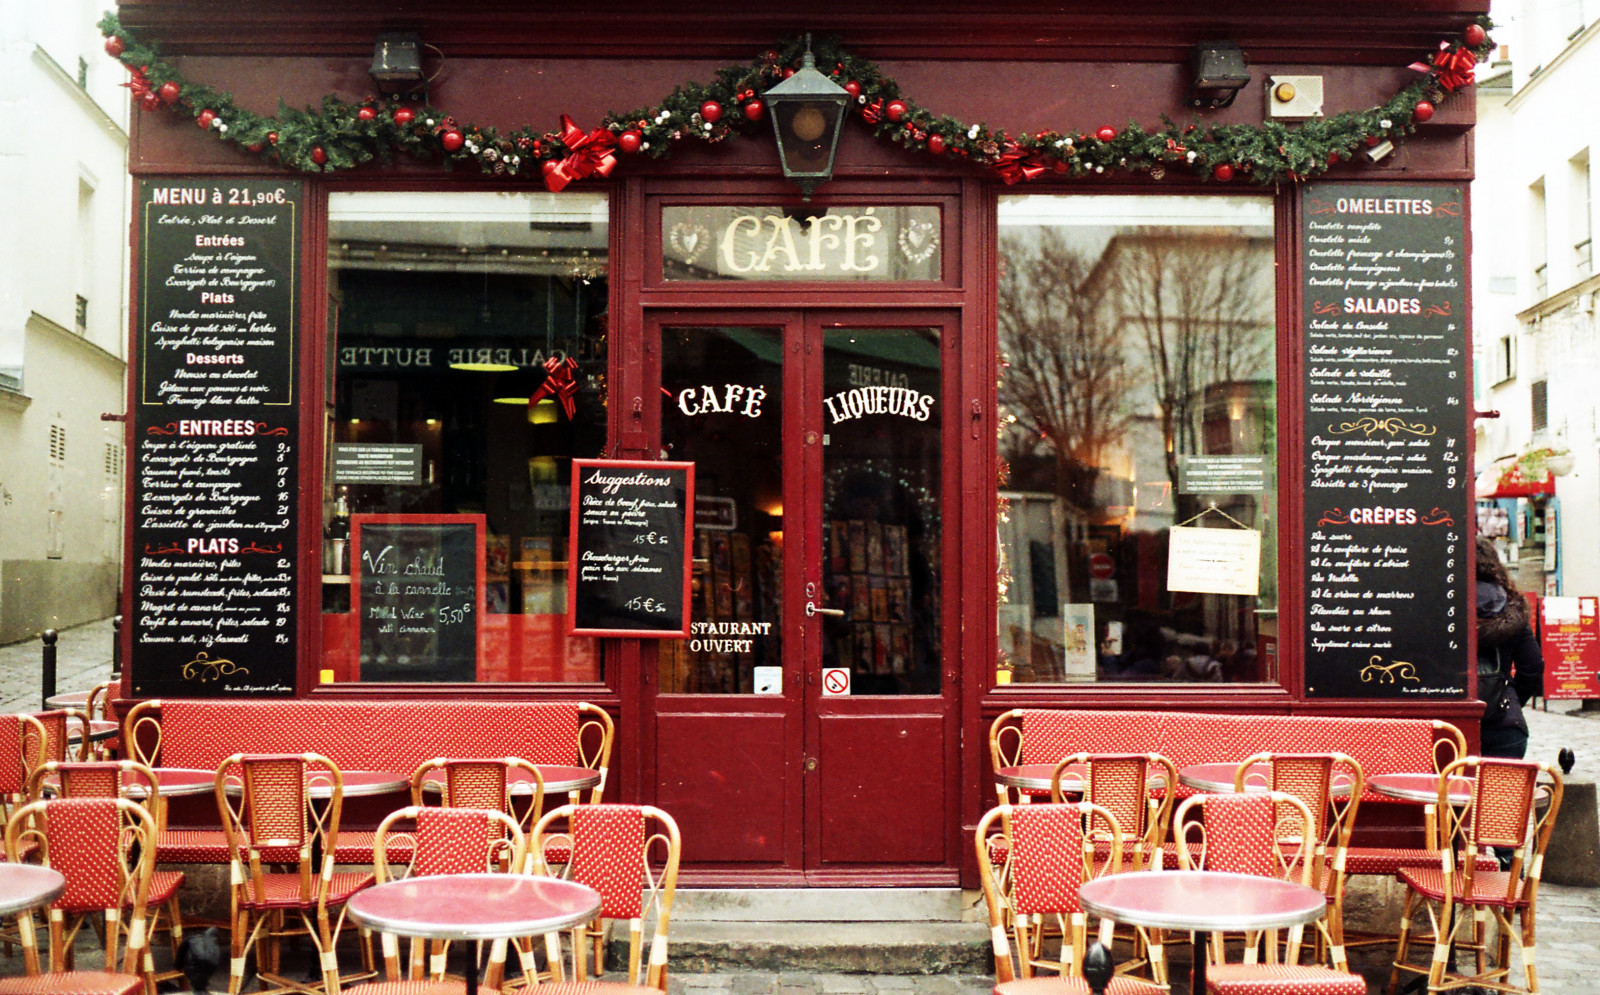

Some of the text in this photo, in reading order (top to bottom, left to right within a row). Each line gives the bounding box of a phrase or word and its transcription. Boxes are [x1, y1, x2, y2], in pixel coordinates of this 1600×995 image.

[154, 188, 285, 206] MENU à 21,90€
[1337, 198, 1433, 214] OMELETTES
[198, 215, 223, 224] Plat
[238, 215, 277, 224] Dessert
[1309, 221, 1344, 230] Omelette
[195, 234, 244, 246] Entrées
[720, 206, 882, 272] CAFÉ
[1309, 235, 1345, 243] Omelette
[184, 253, 214, 264] Soupe
[1309, 248, 1445, 262] Omelette fromage champignons
[173, 264, 265, 278] Terrine campagne
[1310, 262, 1400, 276] Omelette champignons
[165, 276, 206, 291] Escargots
[1309, 277, 1377, 290] Omelette fromage
[202, 292, 234, 303] Plats
[1344, 298, 1420, 314] SALADES
[169, 309, 199, 319] Moules
[151, 322, 276, 336] Cuisse poulet herbes
[1310, 320, 1339, 330] Salade
[1355, 321, 1389, 330] Consulat
[155, 336, 274, 350] Spaghetti bolognaise maison
[1310, 344, 1338, 355] Salade
[187, 353, 244, 364] Desserts
[174, 369, 258, 379] Mousse chocolat
[1310, 368, 1392, 378] Salade volaille
[205, 386, 240, 396] pommes
[167, 394, 260, 409] Fromage blanc battu
[678, 384, 767, 418] CAFÉ
[823, 386, 935, 424] LIQUEURS
[1310, 394, 1342, 403] Salade
[179, 419, 256, 436] ENTRÉES
[141, 439, 167, 453] Soupe
[217, 441, 257, 454] gratinée
[1311, 436, 1341, 451] Croque
[1447, 439, 1456, 448] 11
[149, 453, 258, 466] escargots Bourgogne
[1311, 451, 1341, 465] Croque
[141, 466, 178, 476] Saumon
[206, 467, 231, 476] toasts
[277, 467, 288, 476] 17
[1310, 464, 1456, 478] Spaghetti bolognaise maison 13
[141, 477, 285, 493] Terrine campagne 8
[584, 469, 670, 494] Suggestions
[1311, 477, 1456, 493] Assiette fromages 9
[152, 491, 289, 506] escargots Bourgogne 16
[583, 495, 602, 506] Pièce
[605, 498, 615, 506] de
[141, 505, 289, 519] Cuisses grenouilles 21
[1350, 506, 1417, 524] CRÊPES
[141, 518, 243, 532] L'assiette jambon
[188, 538, 239, 554] PLATS
[1334, 544, 1454, 558] confiture fraise 6
[141, 557, 241, 572] Moules frites
[362, 545, 445, 576] Vin chaud
[1334, 559, 1454, 572] confiture d'abricot 6
[582, 563, 600, 574] pain
[140, 572, 202, 585] Cuisse poulet
[1328, 573, 1454, 583] Nutella 6
[140, 584, 166, 597] Pavé
[375, 581, 384, 594] à
[387, 582, 400, 594] la
[405, 582, 451, 595] cannelle
[1334, 590, 1454, 599] crème marrons 6
[141, 601, 175, 616] Magret
[401, 607, 424, 619] Wine
[439, 603, 471, 625] 5,50€
[1310, 604, 1455, 617] Flambées rhum 8
[140, 616, 167, 630] Confit
[240, 617, 269, 626] salade
[276, 618, 286, 626] 19
[691, 622, 771, 635] STAURANT
[1366, 624, 1392, 632] citron
[1448, 623, 1455, 632] 6
[140, 633, 249, 647] Saumon riz basmati
[690, 639, 753, 652] OUVERT
